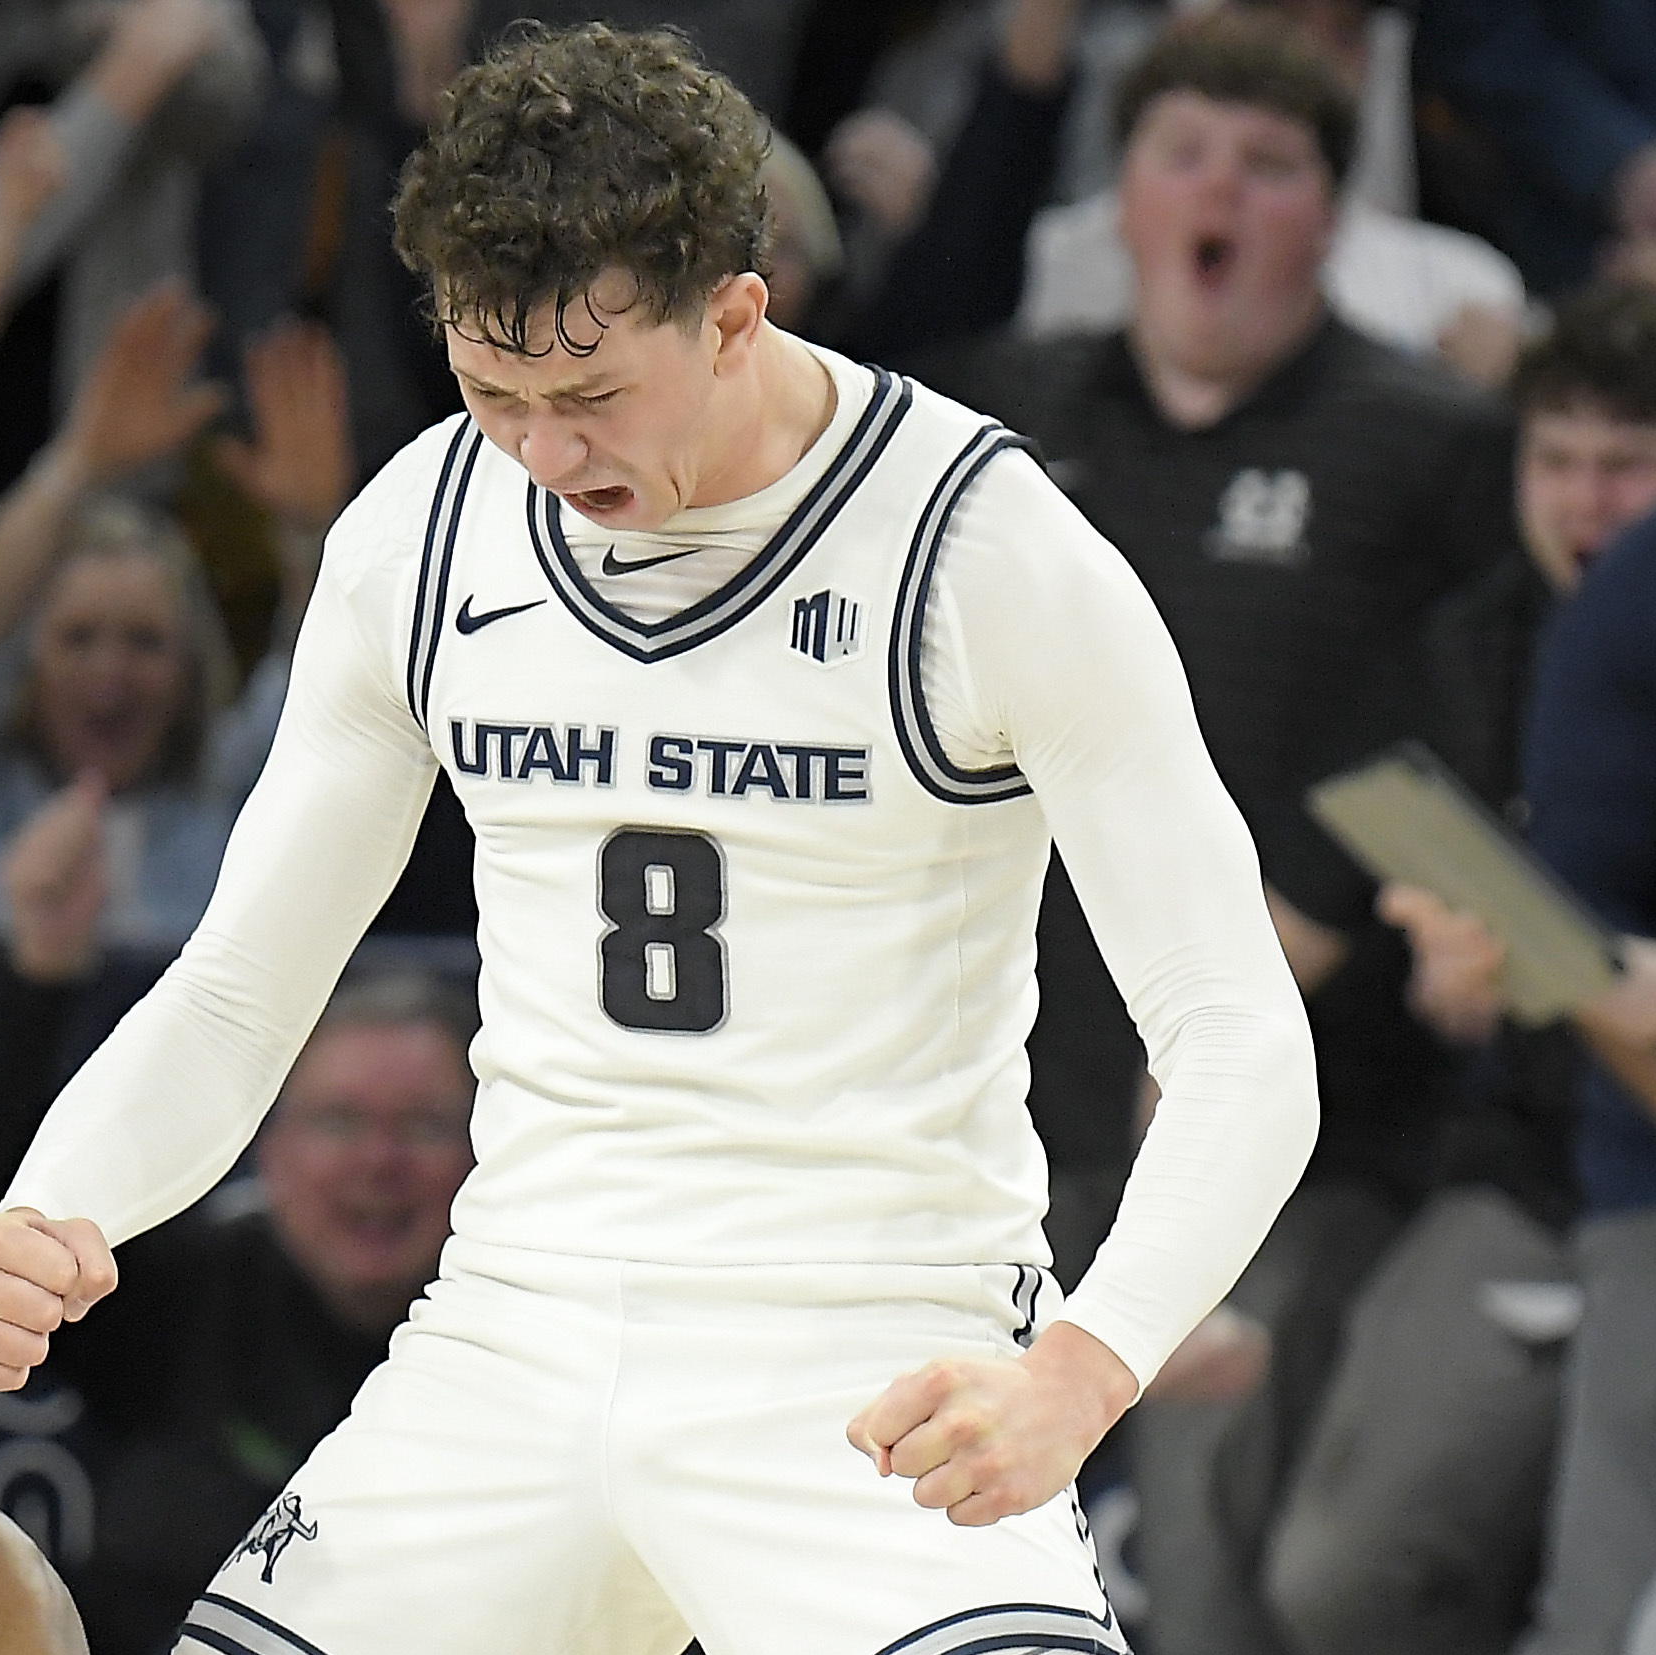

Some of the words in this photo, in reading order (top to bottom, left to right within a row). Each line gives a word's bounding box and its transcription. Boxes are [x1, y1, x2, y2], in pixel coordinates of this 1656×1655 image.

[449, 716, 620, 787] UTAH
[645, 732, 873, 804] STATE
[597, 825, 730, 1037] 8
